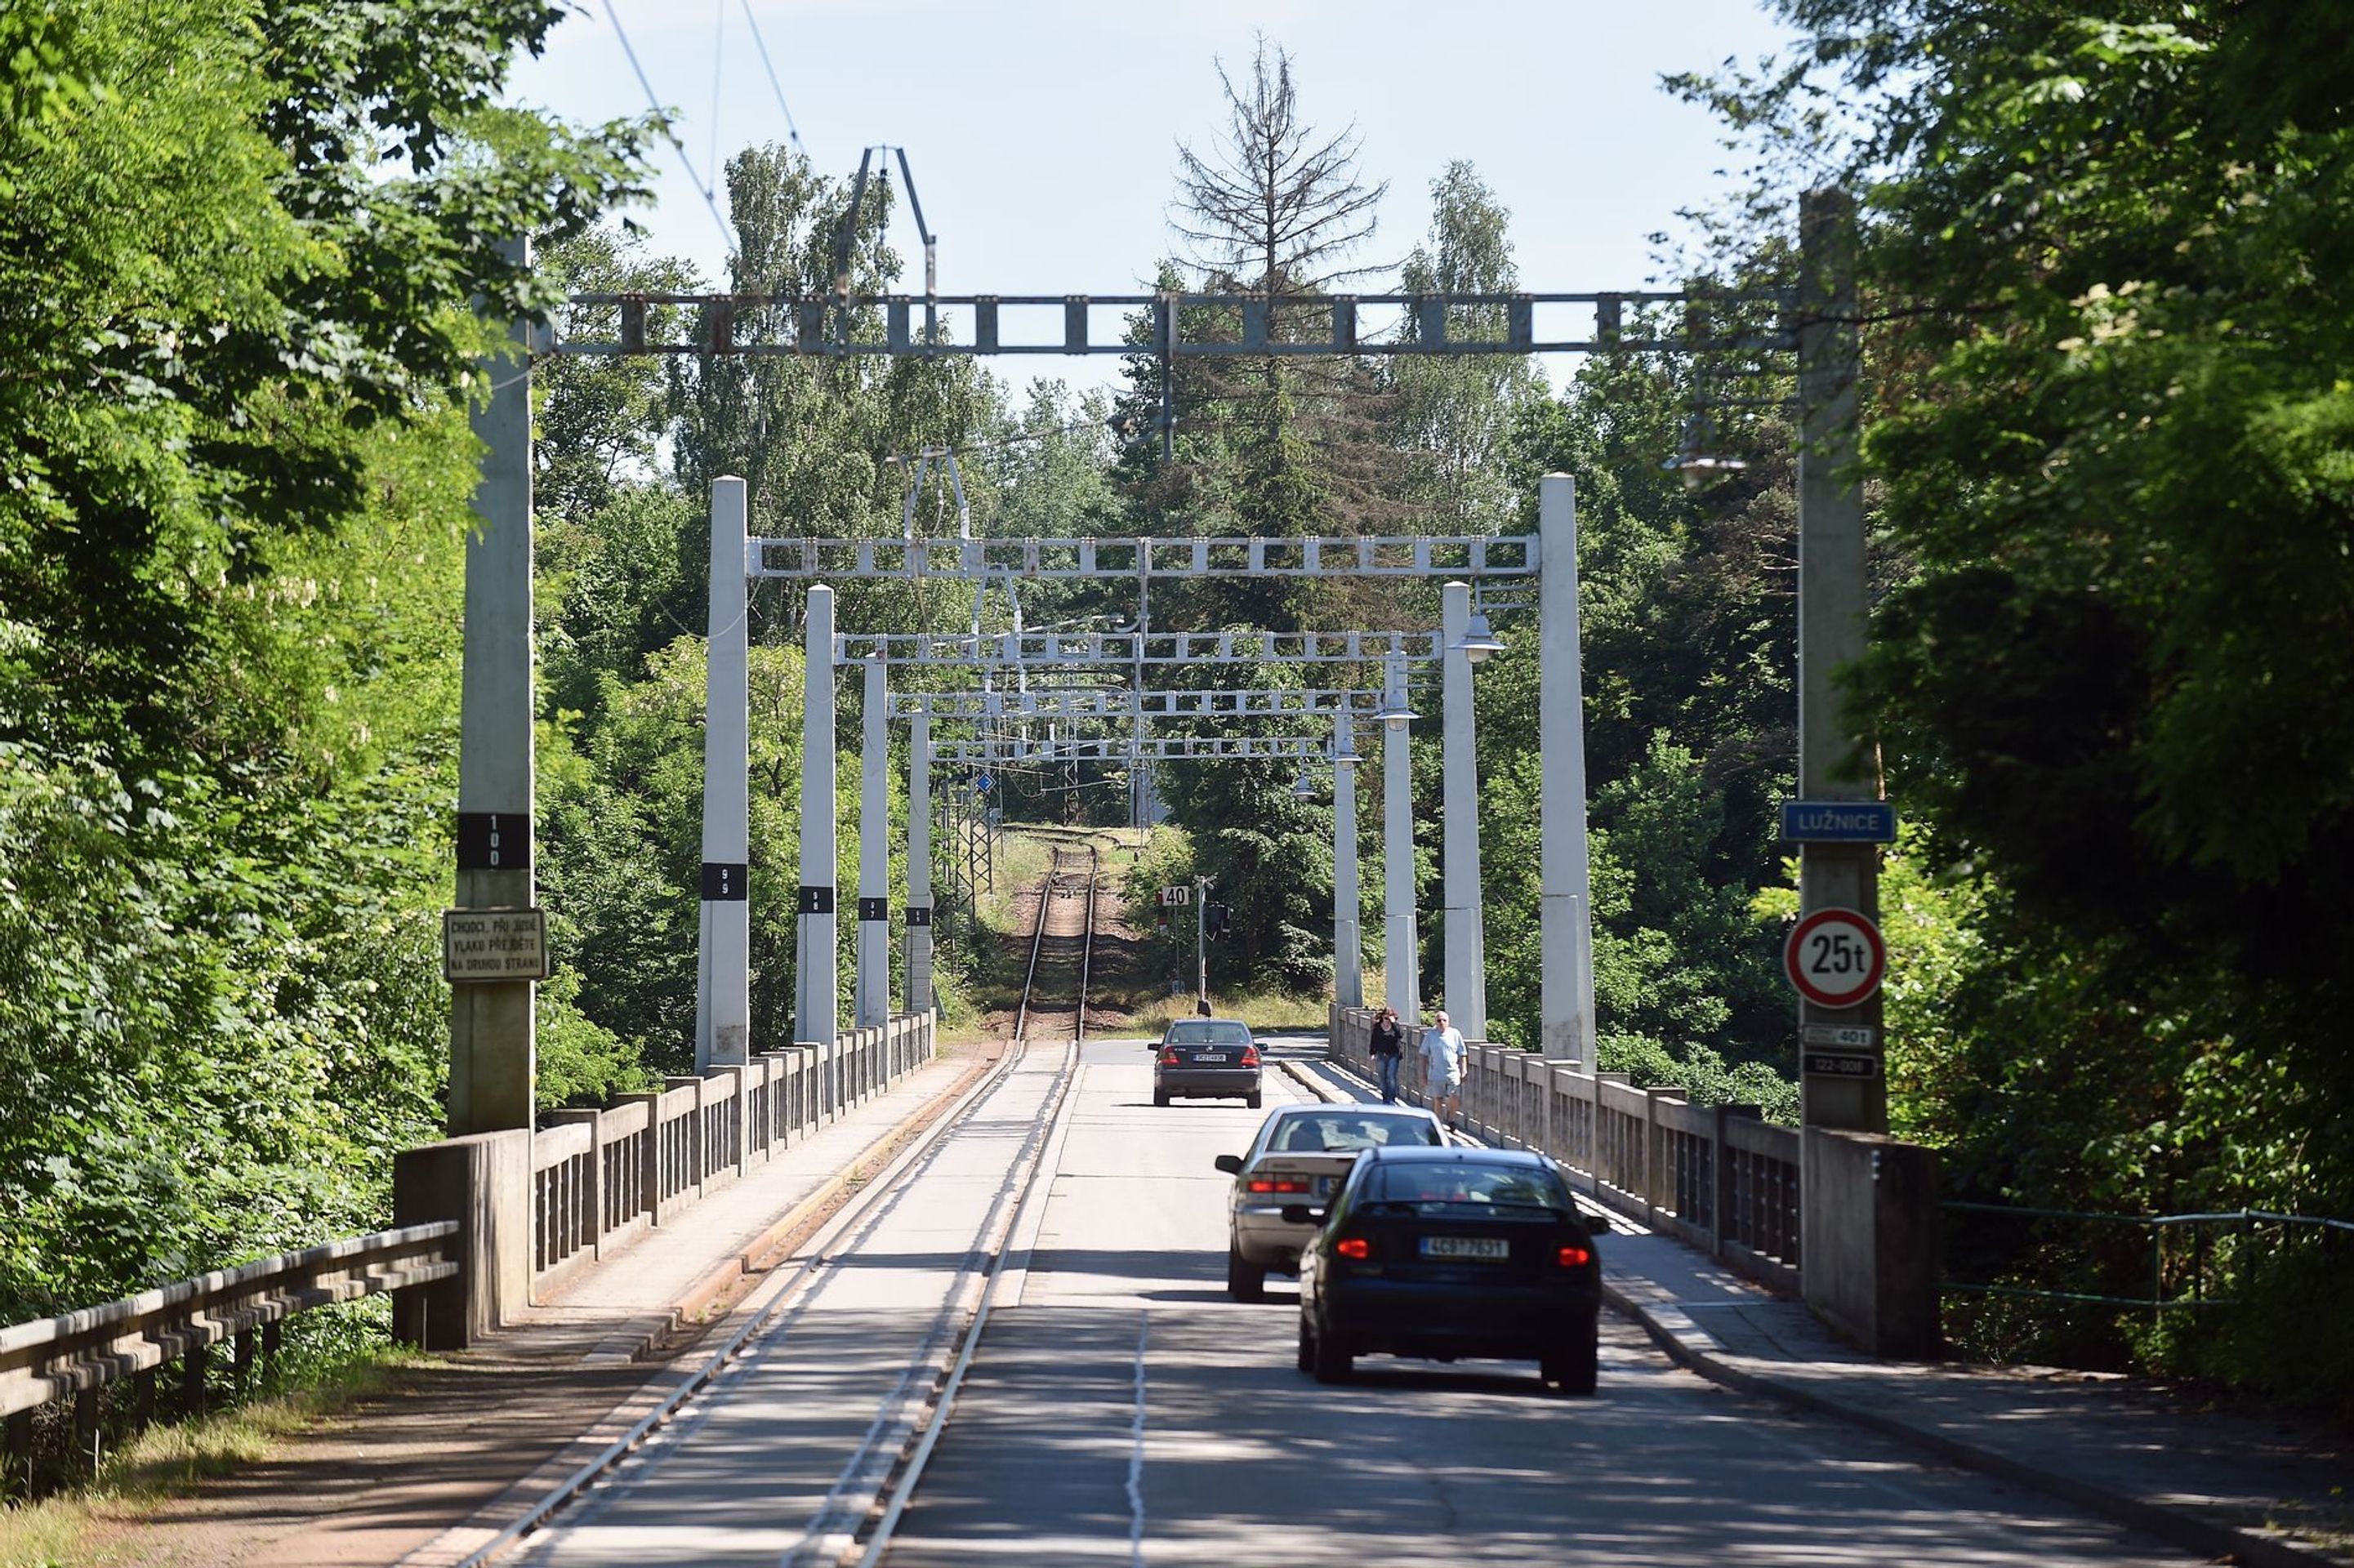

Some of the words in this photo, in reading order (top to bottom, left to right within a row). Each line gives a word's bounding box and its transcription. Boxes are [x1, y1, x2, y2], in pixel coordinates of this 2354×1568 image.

[1799, 808, 1879, 831] LUŽNICE
[490, 814, 500, 866] 100
[1166, 888, 1185, 904] 40
